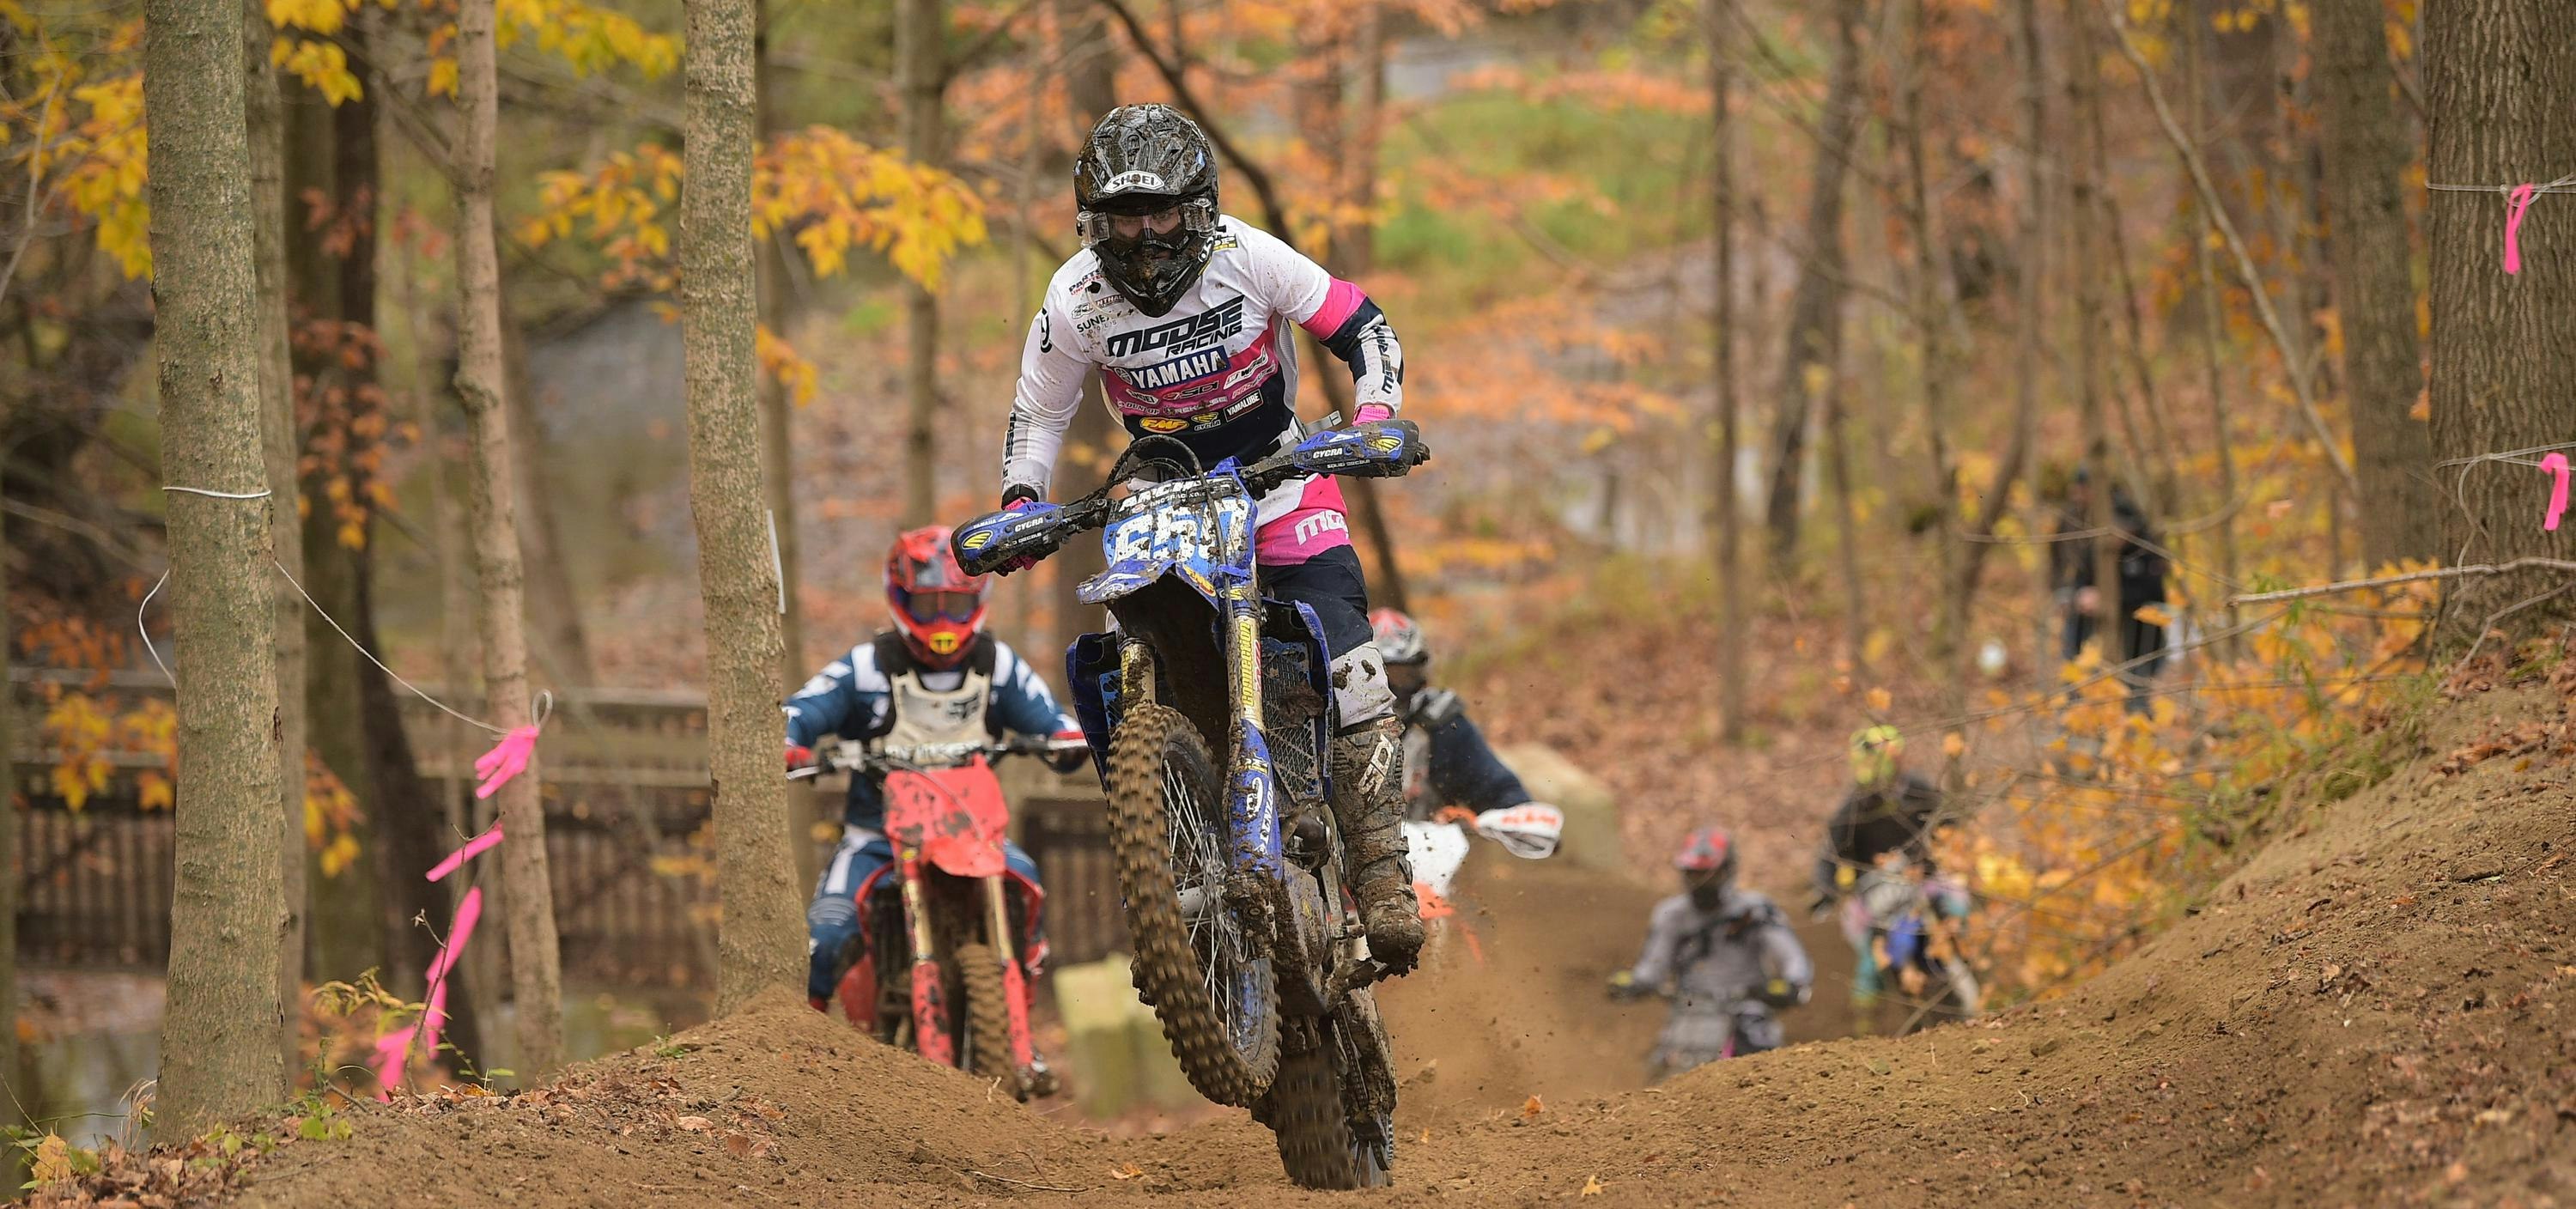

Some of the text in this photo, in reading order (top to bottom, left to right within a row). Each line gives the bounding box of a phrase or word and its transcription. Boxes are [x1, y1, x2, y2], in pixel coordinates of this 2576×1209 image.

[1107, 295, 1245, 358] MOOSE
[1164, 320, 1242, 359] RACING
[1130, 350, 1226, 389] YAMAHA
[1126, 401, 1160, 415] DUNLOP
[1226, 392, 1261, 416] YAMALUBE
[1141, 417, 1188, 429] FMF
[1312, 447, 1343, 459] CYCRA
[973, 519, 997, 529] YAMAHA
[1014, 515, 1044, 533] CYCRA
